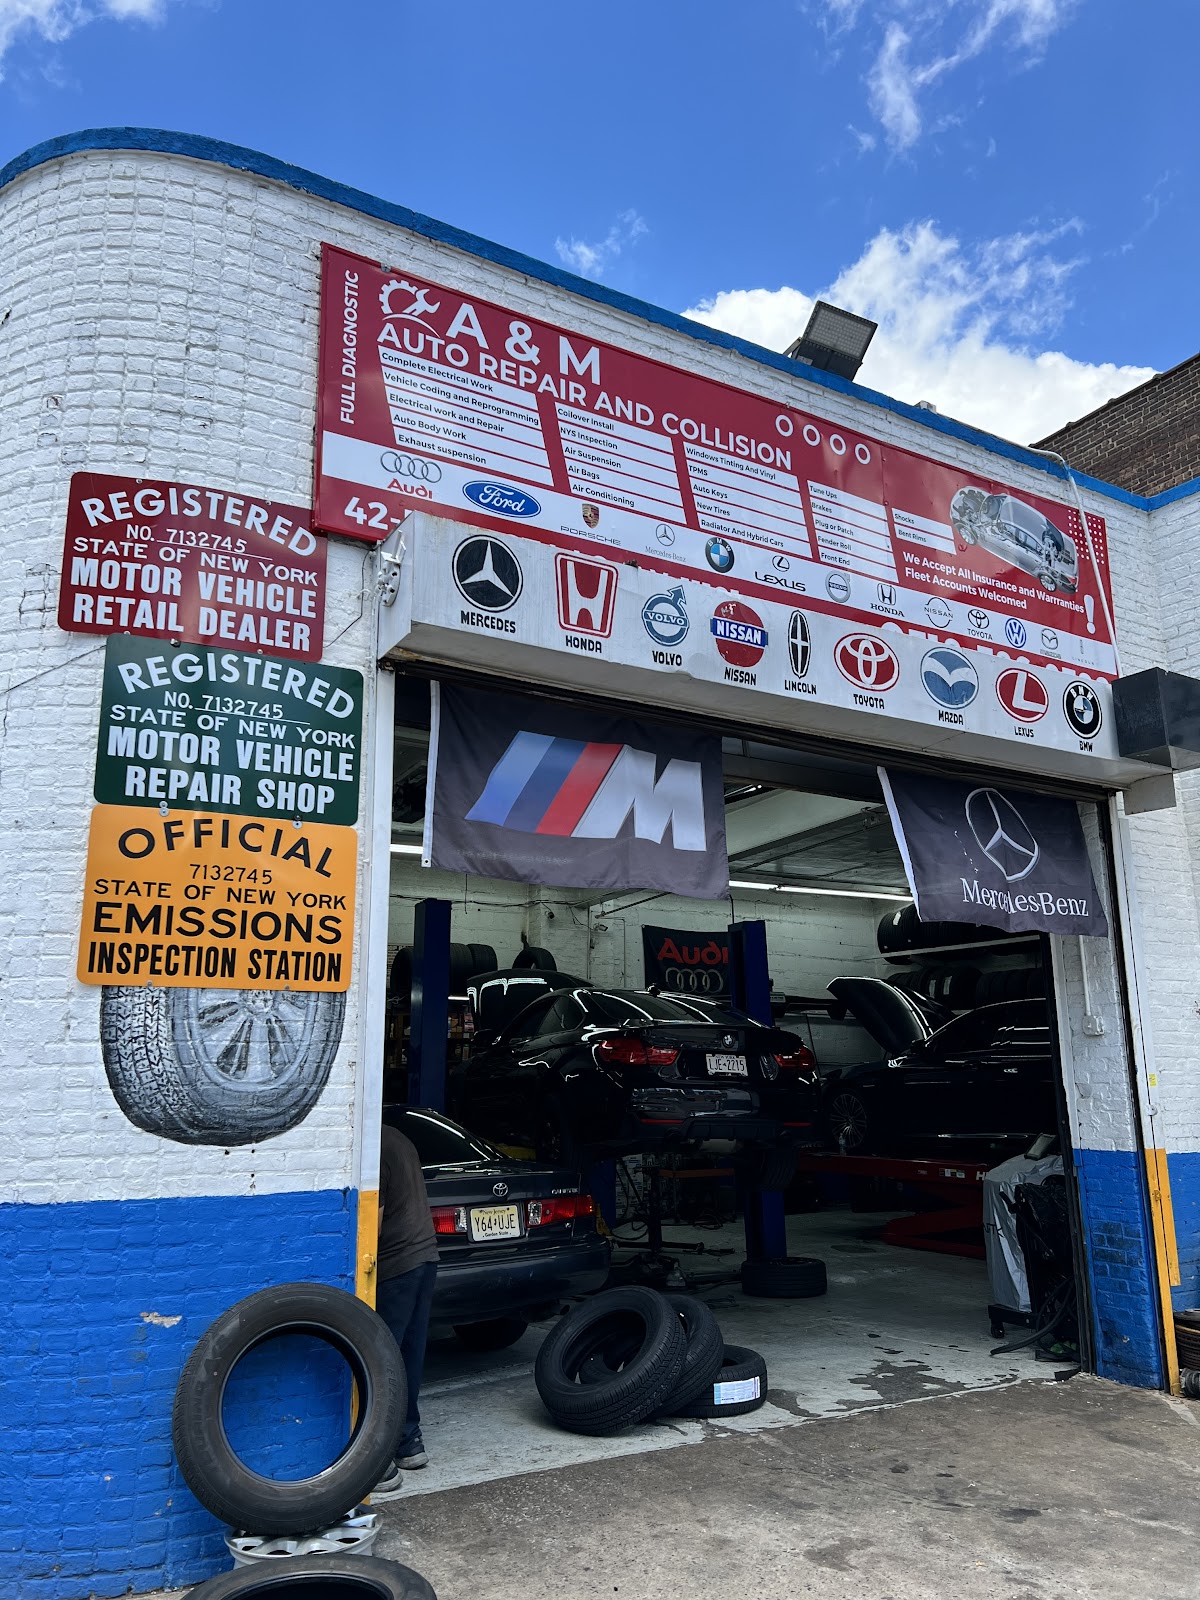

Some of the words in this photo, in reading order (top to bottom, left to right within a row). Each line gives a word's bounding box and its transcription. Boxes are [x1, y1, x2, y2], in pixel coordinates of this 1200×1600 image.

[342, 270, 359, 378] DIAGNOSTIC
[446, 303, 489, 349] A
[505, 320, 540, 366] &
[559, 335, 601, 385] M
[382, 352, 427, 372] Complete
[428, 366, 469, 385] Electrical
[470, 379, 494, 393] Work
[341, 382, 356, 425] FULL
[377, 322, 470, 367] AUTO
[480, 352, 586, 407] REPAIR
[594, 392, 655, 426] AND
[662, 412, 791, 470] COLLISION
[384, 372, 418, 388] Vehicle
[420, 382, 451, 399] Coding
[453, 393, 470, 404] and
[472, 398, 539, 426] Reprogramming
[390, 393, 432, 411] Electrical
[434, 406, 457, 419] work
[459, 413, 475, 424] and
[477, 418, 505, 434] Repair
[557, 408, 589, 423] Coilover
[591, 418, 615, 431] Install
[394, 414, 416, 426] Auto
[418, 421, 441, 434] Body
[442, 427, 467, 440] Work
[560, 427, 577, 437] NYS
[578, 432, 618, 450] Inspection
[398, 434, 436, 451] Exhaust
[437, 445, 487, 465] suspension
[564, 446, 576, 455] Air
[577, 450, 621, 468] Suspension
[568, 465, 580, 474] Air
[581, 469, 600, 480] Bags
[686, 447, 719, 462] Windows
[720, 457, 744, 471] Tinting
[745, 465, 759, 475] And
[760, 470, 776, 480] Vinyl
[688, 465, 708, 476] TPMS
[478, 484, 526, 513] Ford
[572, 484, 584, 493] Air
[585, 487, 635, 508] Conditioning
[693, 484, 711, 494] Auto
[711, 489, 728, 499] Keys
[809, 485, 825, 496] Tune
[825, 490, 838, 500] Ups
[696, 501, 713, 511] New
[714, 506, 731, 516] Tires
[811, 502, 832, 514] Brakes
[894, 513, 915, 525] Shocks
[80, 487, 317, 557] REGISTERED
[701, 519, 730, 533] Radiator
[731, 527, 746, 537] And
[746, 530, 769, 544] Hybrid
[769, 538, 784, 548] Cars
[815, 519, 829, 530] Plug
[837, 525, 854, 536] Patch
[126, 524, 155, 542] NO.
[166, 528, 247, 553] 7132745
[560, 525, 622, 546] PORSCHE
[818, 535, 839, 547] Fender
[840, 542, 852, 551] Roll
[898, 529, 912, 539] Bent
[912, 533, 927, 543] Rims
[73, 536, 148, 559] STATE
[158, 546, 190, 563] OF
[200, 551, 249, 574] NEW
[258, 561, 318, 587] YORK
[821, 552, 838, 563] Front
[838, 557, 851, 566] End
[754, 571, 806, 592] LEXUS
[903, 551, 921, 565] We
[921, 556, 956, 576] Accept
[957, 567, 971, 580] All
[972, 571, 1018, 593] Insurance
[1018, 586, 1036, 598] and
[70, 557, 182, 597] MOTOR
[197, 570, 317, 618] VEHICLE
[905, 566, 931, 583] Fleet
[932, 575, 977, 596] Accounts
[977, 587, 1028, 609] Welcomed
[73, 593, 184, 633] RETAIL
[198, 606, 311, 652] DEALER
[460, 610, 516, 634] MERCEDES
[646, 611, 685, 626] VOLVO
[870, 603, 906, 618] HONDA
[924, 607, 954, 619] NISSAN
[565, 634, 602, 654] HONDA
[716, 619, 762, 645] NISSAN
[967, 628, 994, 641] TOYOTA
[652, 650, 683, 667] VOLVO
[117, 652, 355, 719] REGISTERED
[724, 666, 757, 686] NISSAN
[784, 679, 817, 696] LINCOLN
[163, 690, 193, 710] NO.
[201, 694, 283, 719] 7132745
[853, 693, 885, 710] TOYOTA
[110, 704, 186, 728] STATE
[197, 714, 229, 732] OF
[238, 719, 287, 740] NEW
[297, 727, 356, 750] YORK
[938, 709, 964, 726] MAZDA
[1014, 725, 1035, 738] LEXUS
[107, 725, 221, 767] MOTOR
[236, 739, 354, 782] VEHICLE
[1079, 740, 1094, 753] BMW
[124, 765, 242, 806] REPAIR
[256, 778, 336, 814] SHOP
[118, 818, 332, 878] OFFICIAL
[189, 863, 273, 885] 7132745
[93, 878, 172, 898] STATE
[184, 884, 216, 901] OF
[226, 887, 276, 905] NEW
[286, 891, 347, 910] YORK
[93, 901, 342, 945] EMISSIONS
[88, 941, 237, 978] INSPECTION
[247, 948, 342, 982] STATION
